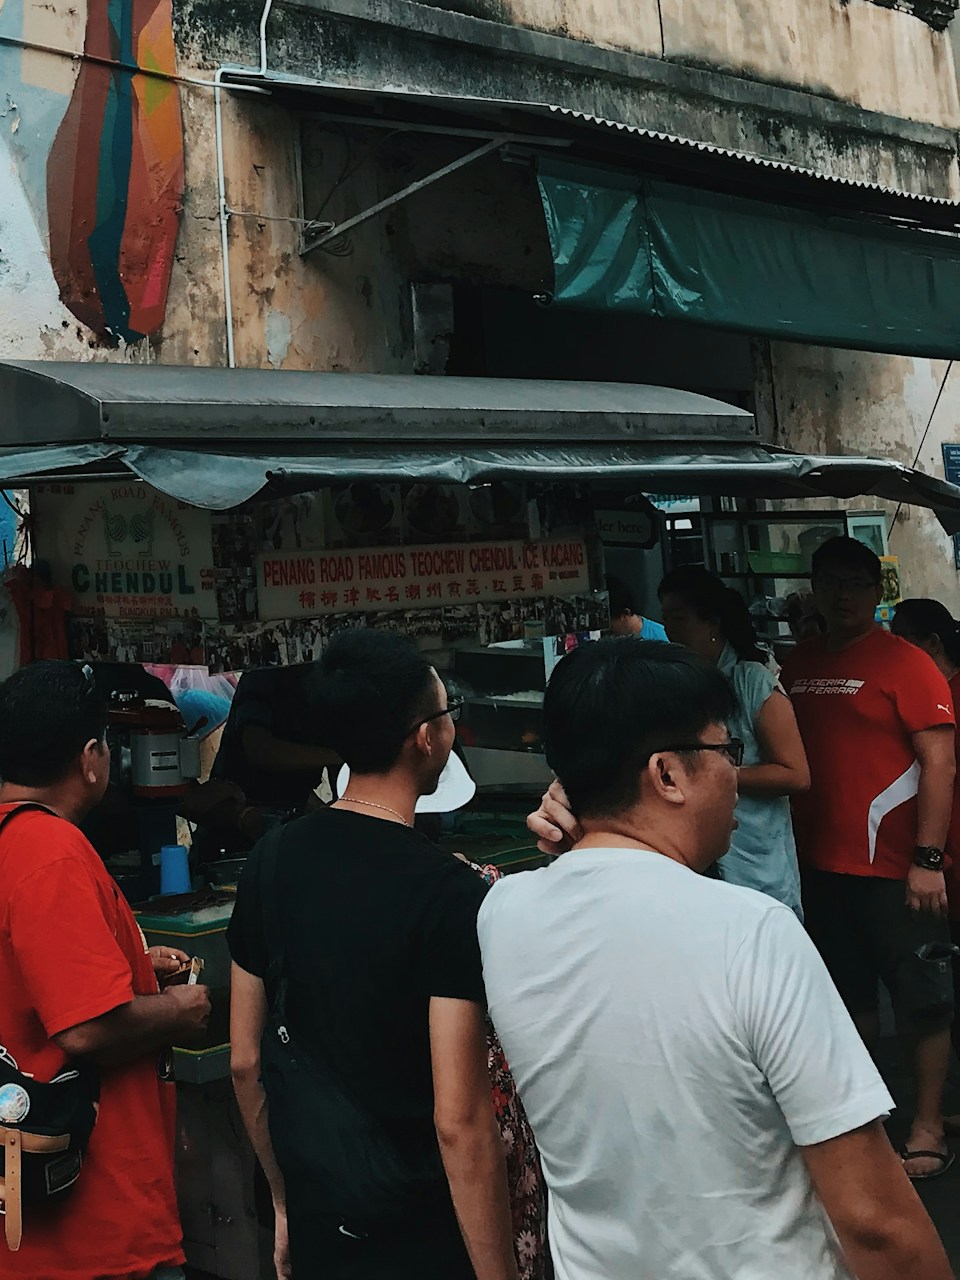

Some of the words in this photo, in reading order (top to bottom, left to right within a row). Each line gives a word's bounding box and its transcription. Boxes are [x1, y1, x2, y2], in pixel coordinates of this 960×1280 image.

[73, 495, 106, 557] PENANG
[111, 486, 146, 501] ROAD
[152, 496, 190, 558] FAMOUS
[95, 559, 172, 571] TEOCHEW
[263, 560, 316, 587] PENANG
[320, 558, 354, 583] ROAD
[359, 554, 406, 580] FAMOUS
[410, 550, 465, 577] TEOCHEW
[469, 547, 517, 573] CHENDUL
[542, 543, 584, 567] KACANG
[71, 563, 195, 594] CHENDUL
[793, 678, 846, 686] SCUDERIA
[807, 686, 859, 695] FERRARI
